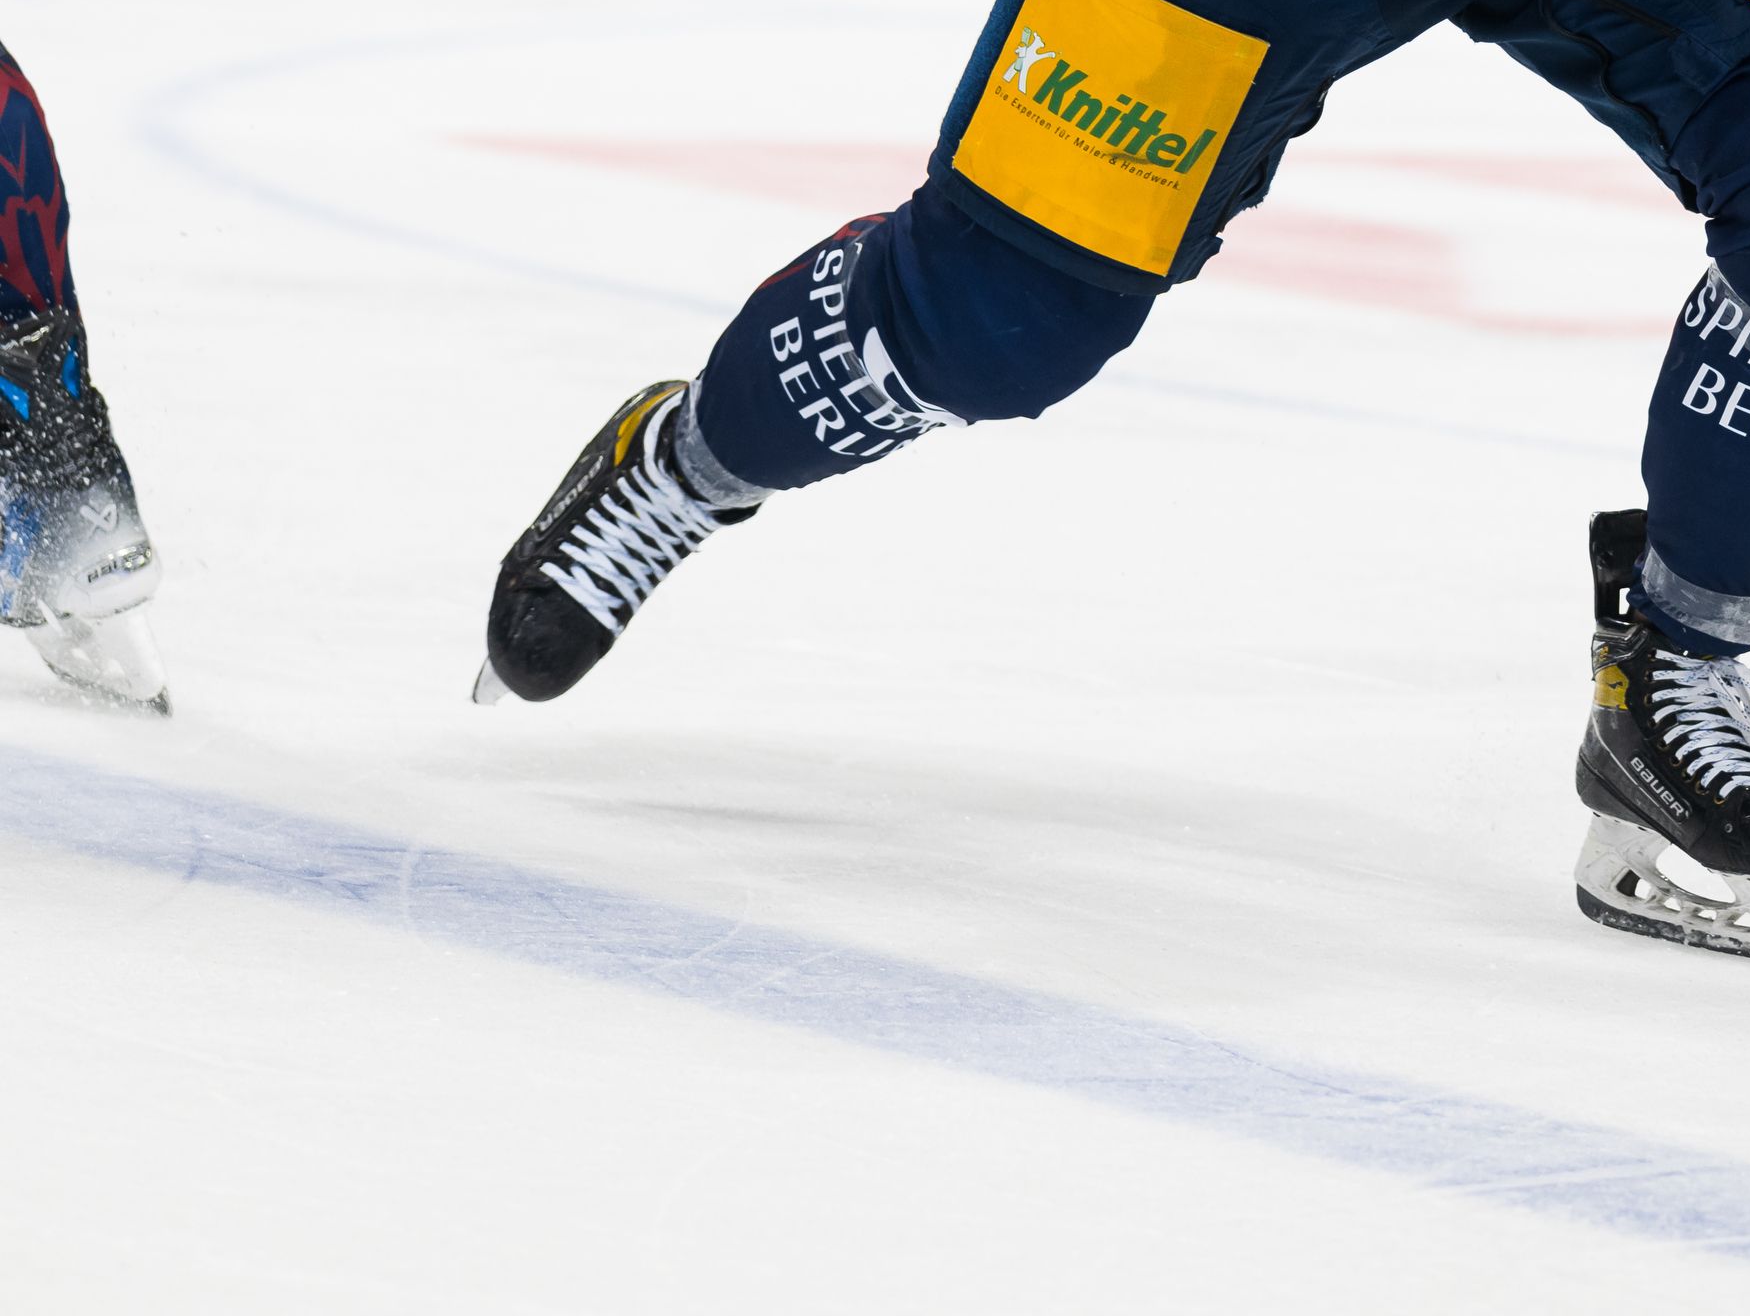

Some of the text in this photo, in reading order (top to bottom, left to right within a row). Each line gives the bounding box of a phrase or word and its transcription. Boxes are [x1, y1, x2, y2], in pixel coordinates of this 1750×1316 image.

[994, 85, 1009, 102] Die
[1011, 98, 1053, 131] Experten
[1054, 126, 1070, 141] für
[1073, 137, 1107, 159] Maler
[1108, 154, 1117, 165] &
[1033, 59, 1218, 175] Knittel
[1631, 756, 1685, 817] BAUER
